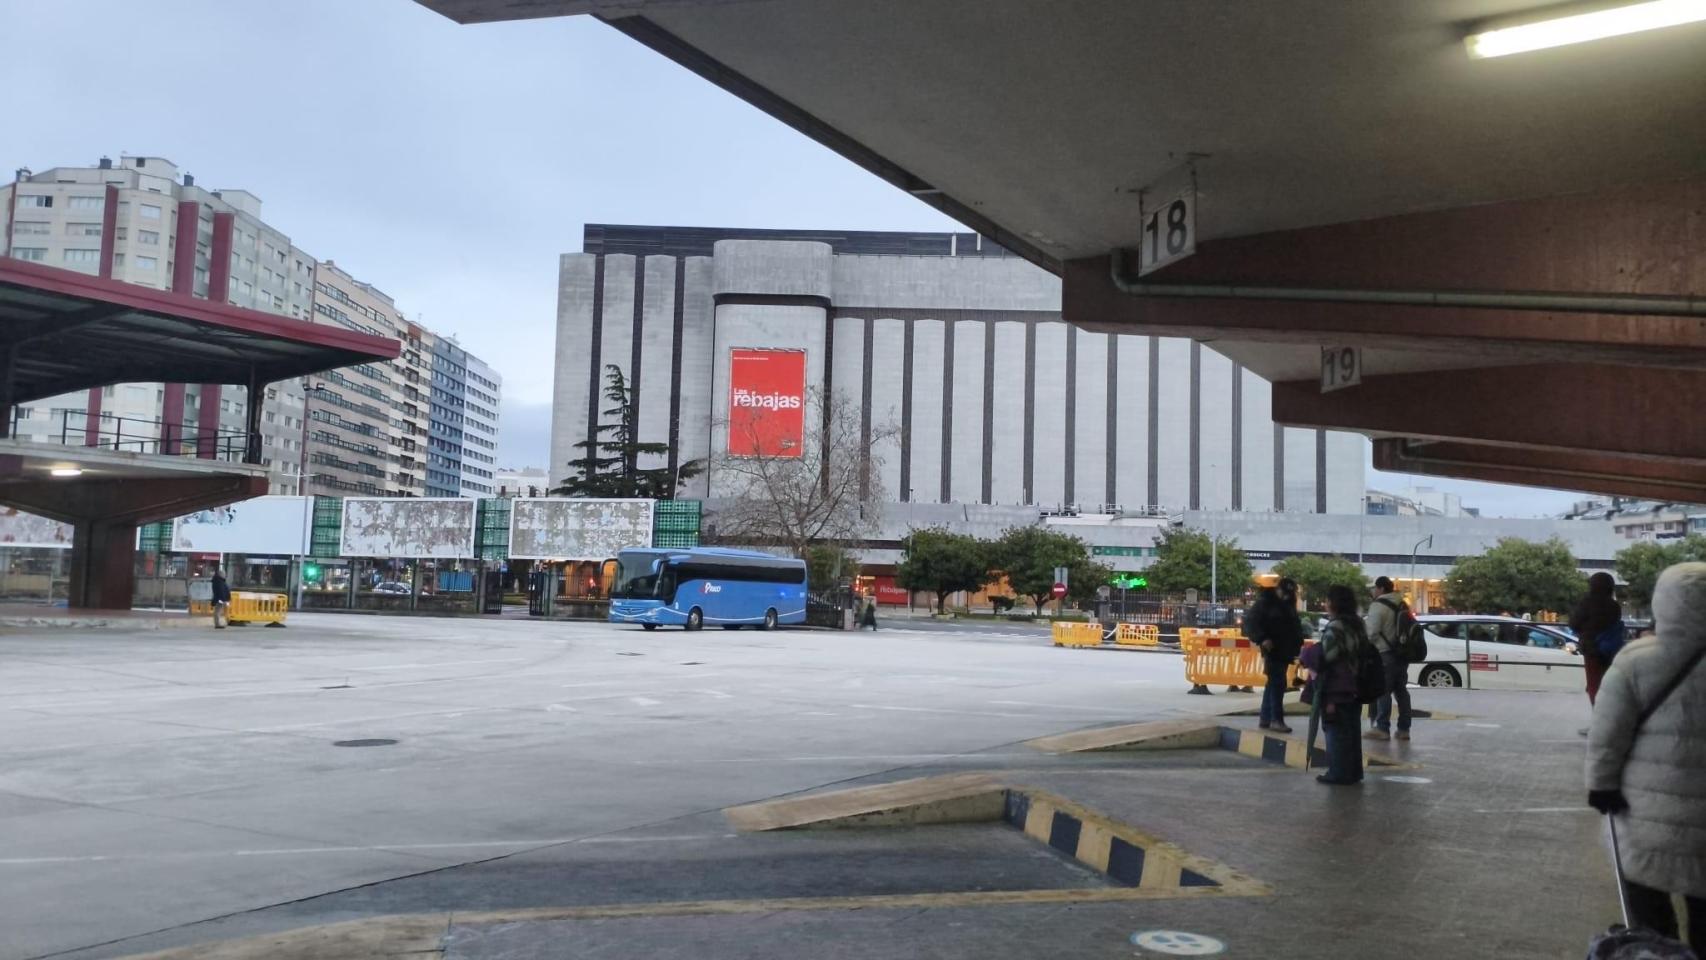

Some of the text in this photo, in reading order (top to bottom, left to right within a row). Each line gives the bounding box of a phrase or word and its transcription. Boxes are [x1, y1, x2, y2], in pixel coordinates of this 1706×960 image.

[1145, 199, 1187, 264] 18
[1325, 347, 1356, 386] 19
[734, 392, 800, 411] rebajas
